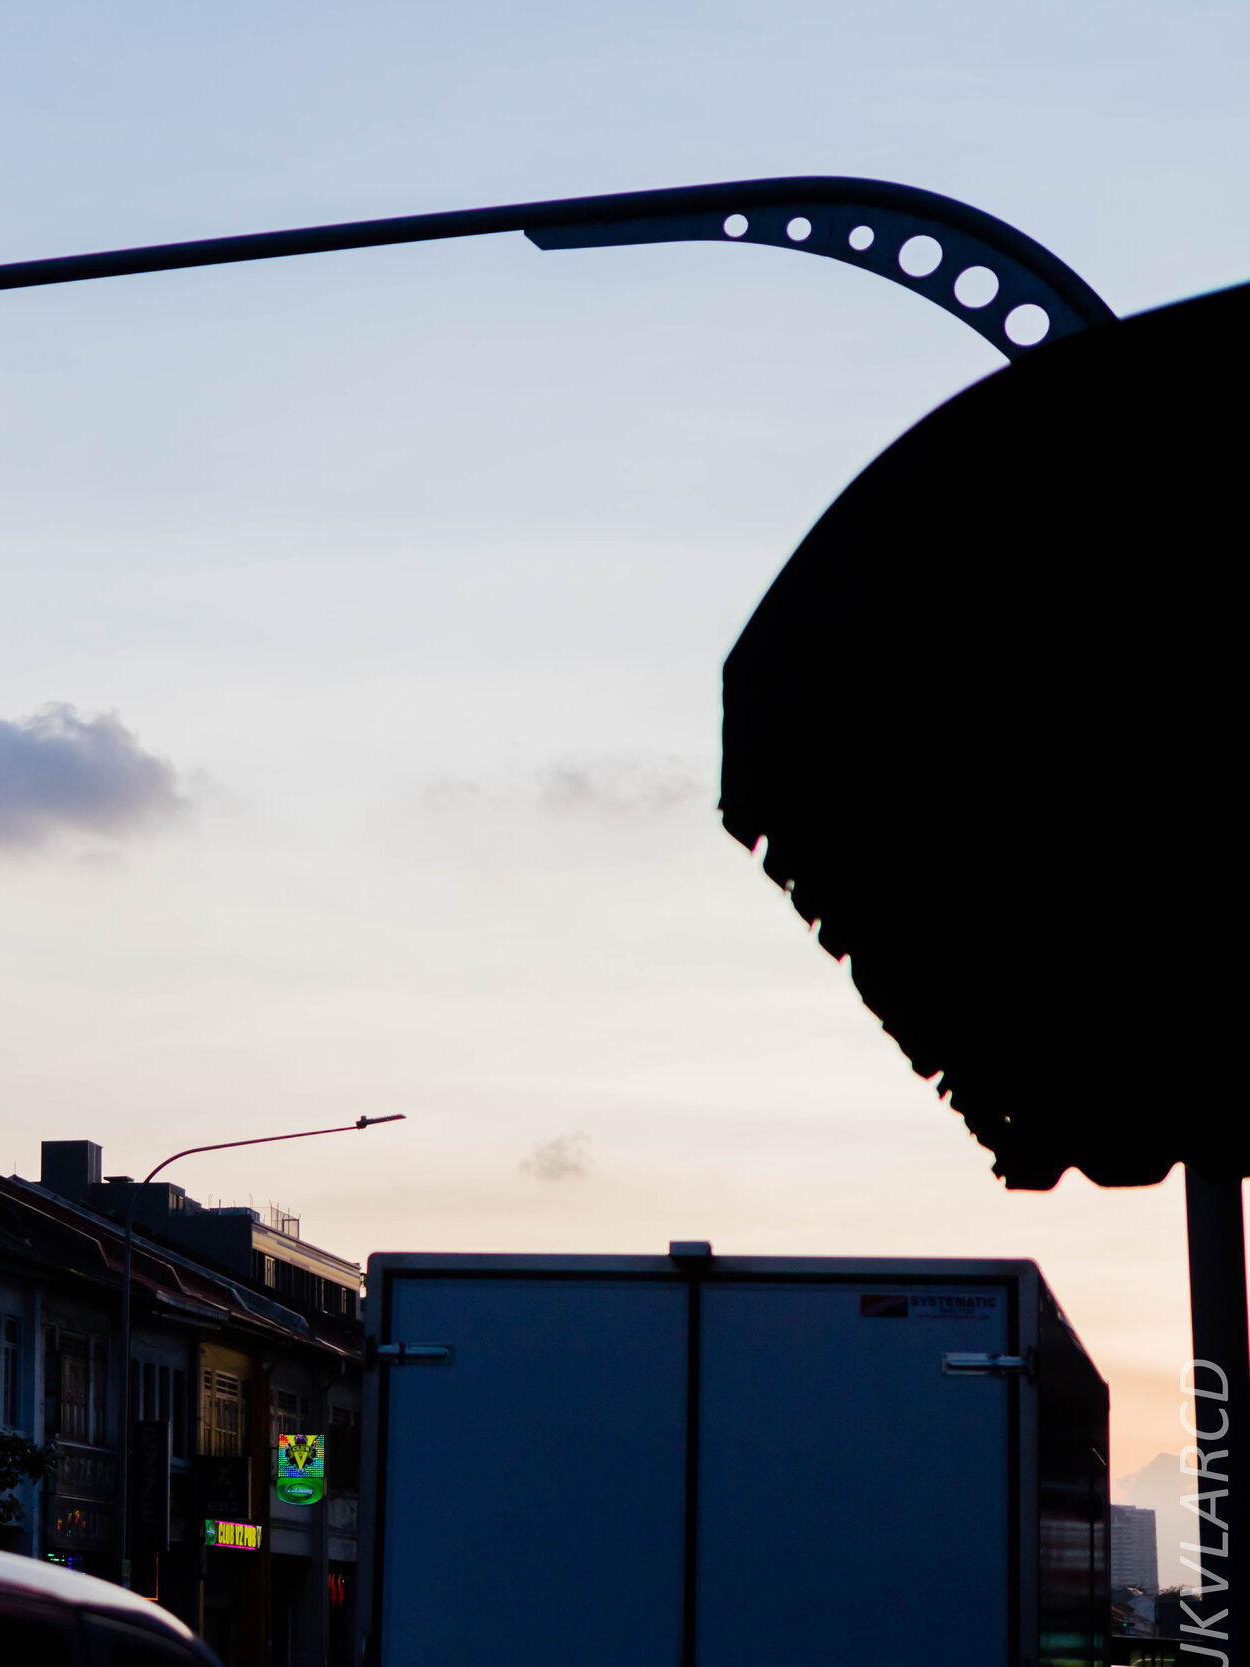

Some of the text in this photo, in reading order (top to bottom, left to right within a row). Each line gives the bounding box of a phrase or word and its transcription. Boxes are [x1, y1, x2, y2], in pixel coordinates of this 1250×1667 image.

[910, 1295, 996, 1307] SYSTEMATIC
[218, 1522, 235, 1545] CLUB
[244, 1526, 257, 1548] PUB
